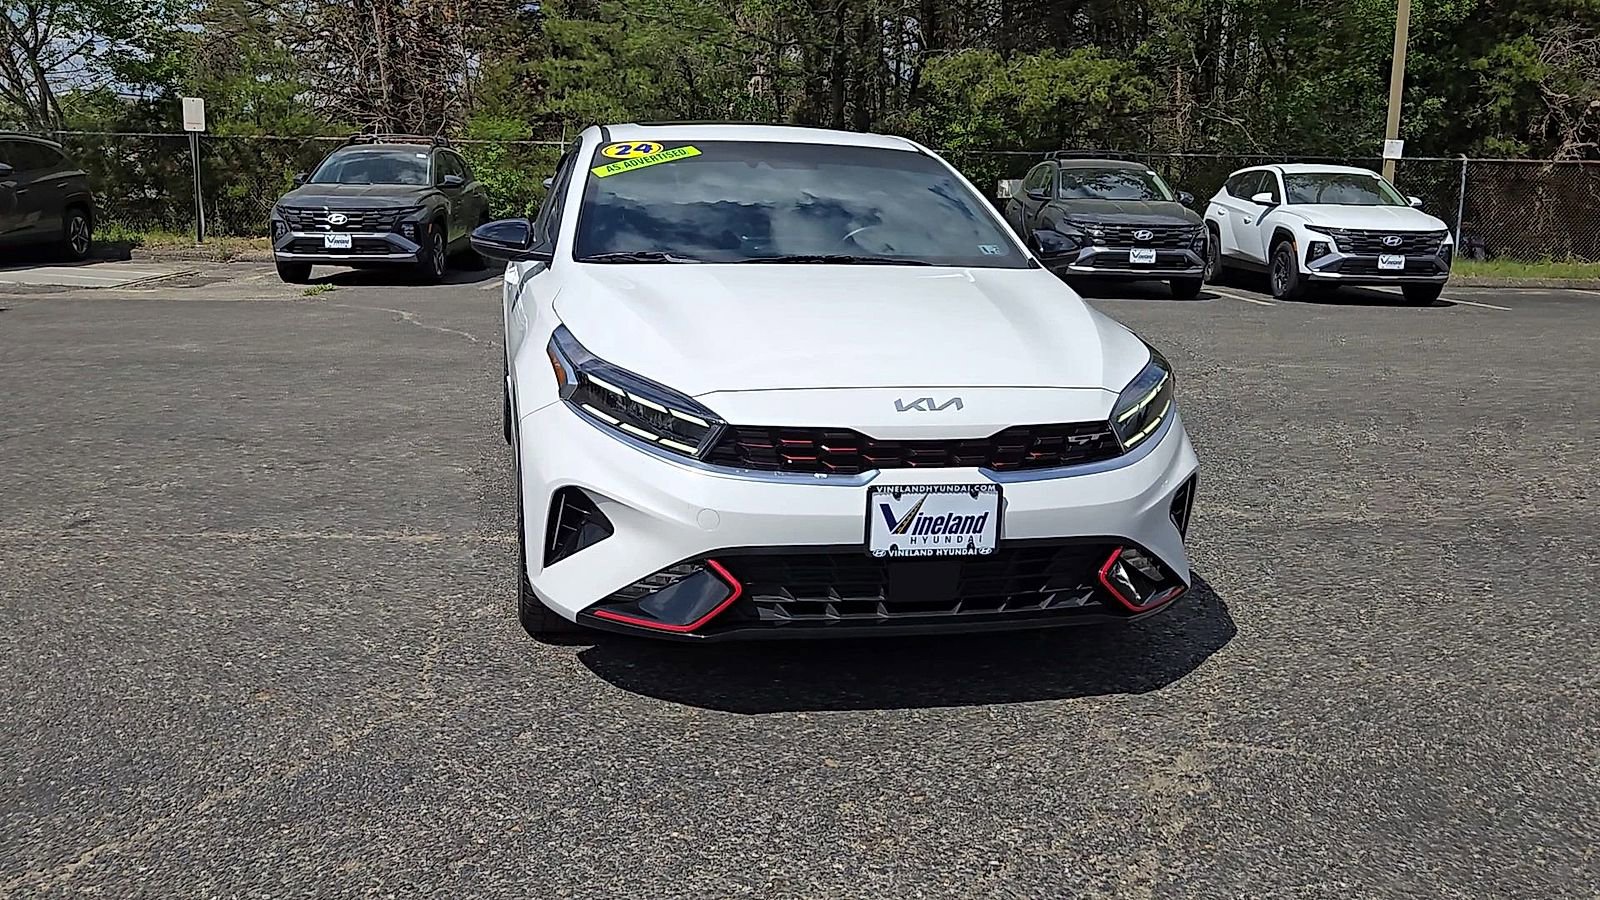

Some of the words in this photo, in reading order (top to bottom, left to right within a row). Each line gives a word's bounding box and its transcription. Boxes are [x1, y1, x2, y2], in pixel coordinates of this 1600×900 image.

[615, 144, 653, 155] 24
[606, 163, 621, 173] AS
[894, 397, 964, 412] KIA
[876, 484, 996, 493] VINELANDHYUNDAI.COM
[879, 493, 990, 535] Vineland
[910, 535, 983, 545] HYUNDAI
[888, 549, 933, 557] VINELAND
[936, 548, 977, 556] HYUNDAI
